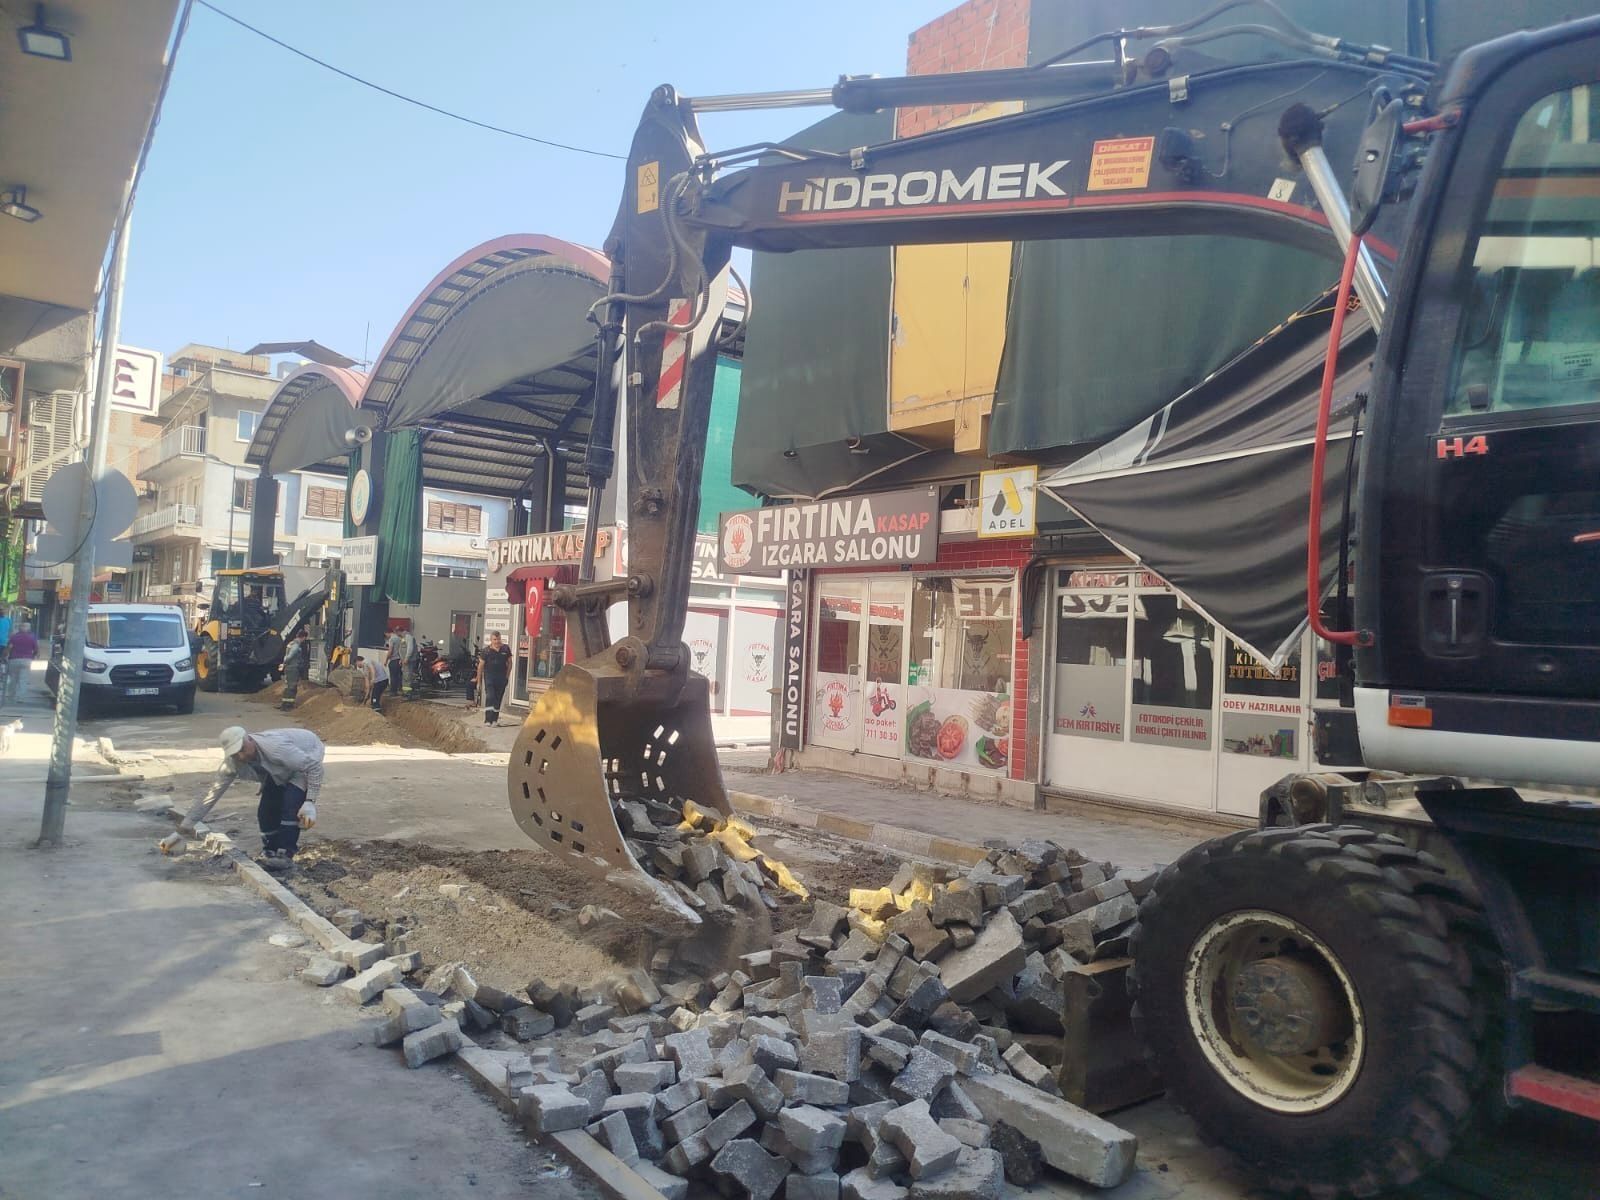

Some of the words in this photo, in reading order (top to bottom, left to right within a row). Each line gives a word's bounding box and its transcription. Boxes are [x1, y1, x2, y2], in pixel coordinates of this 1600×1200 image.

[1437, 435, 1489, 459] H4
[757, 498, 876, 543] FIRTINA
[876, 511, 930, 533] KASAP
[988, 518, 1025, 530] ADEL
[500, 537, 553, 564] FIRTINA
[553, 530, 610, 561] KASP
[762, 541, 828, 566] IZGARA
[834, 534, 921, 563] SALONU
[789, 568, 804, 639] ZGARA
[786, 645, 801, 736] SALONU
[1248, 702, 1302, 714] HAZIRLANIR
